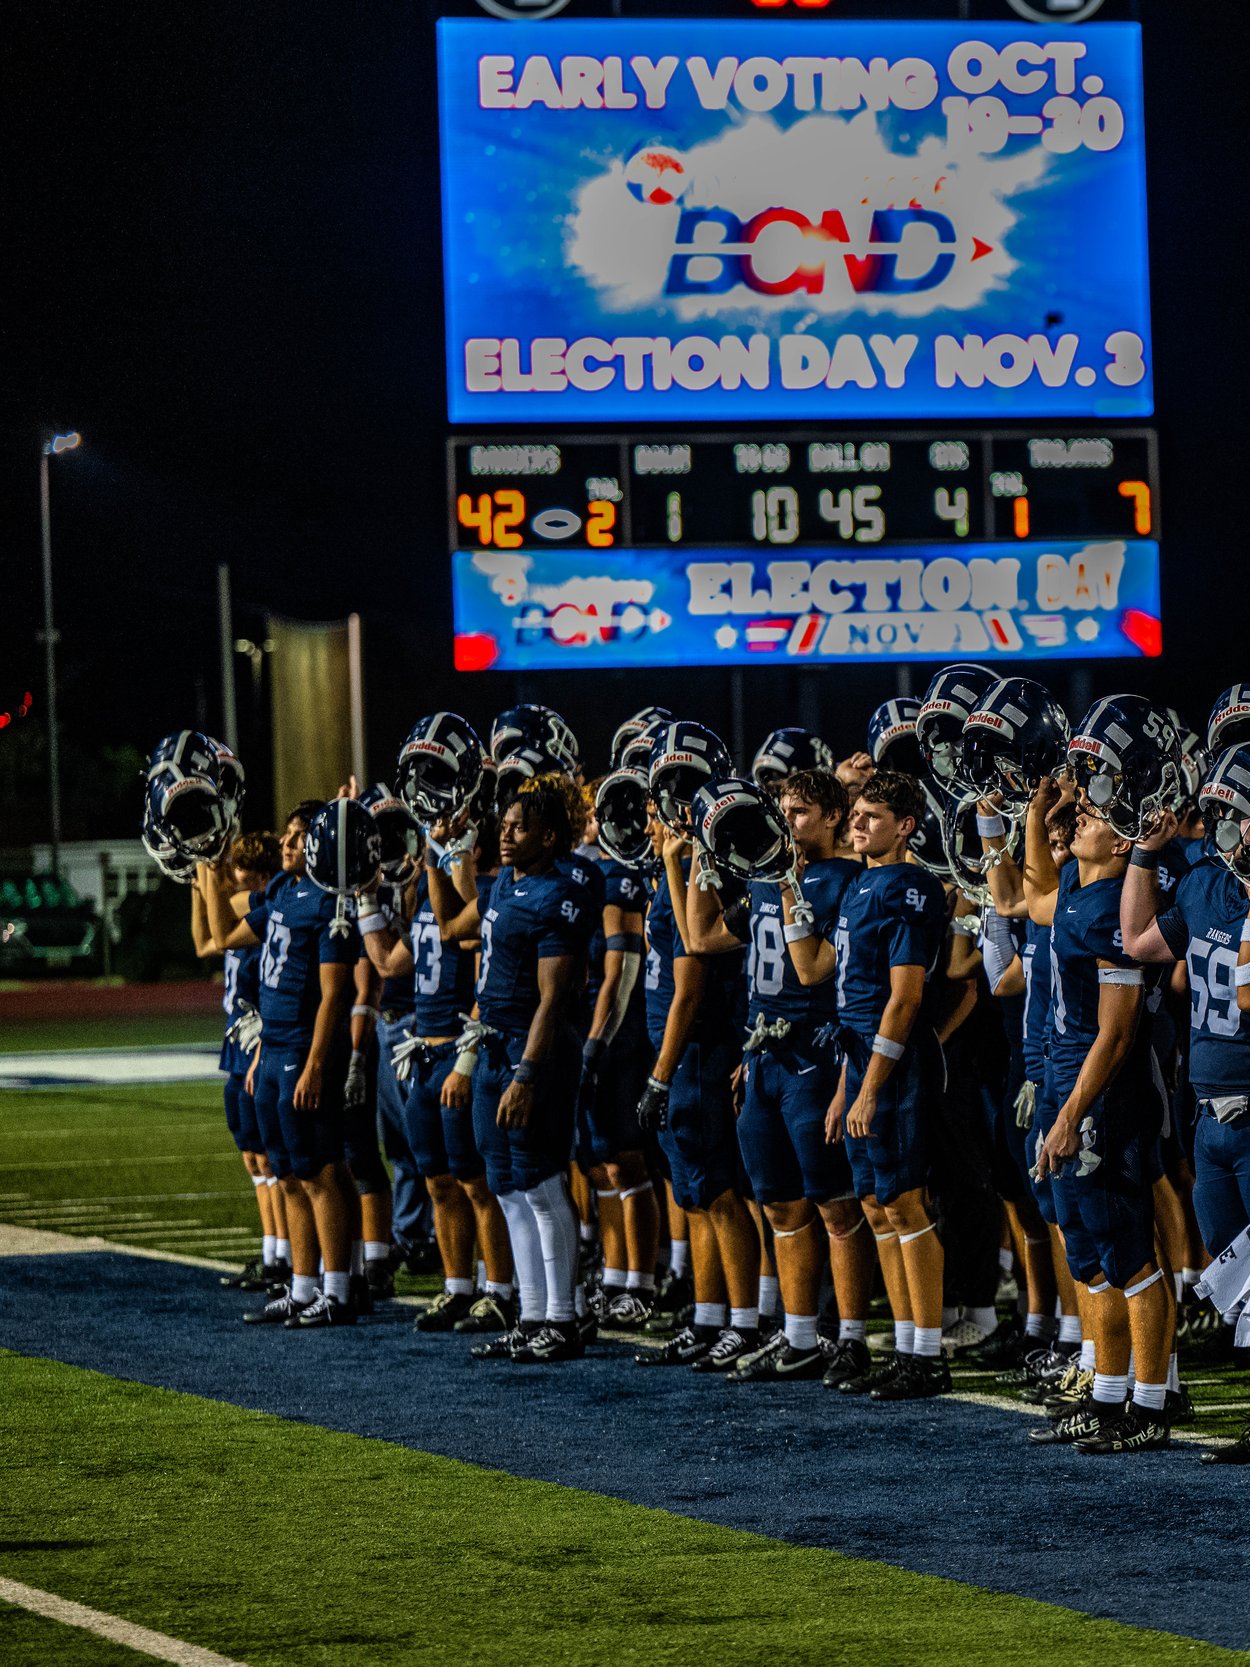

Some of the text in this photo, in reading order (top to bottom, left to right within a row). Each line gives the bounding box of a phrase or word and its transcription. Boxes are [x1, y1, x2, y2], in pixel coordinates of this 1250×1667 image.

[479, 40, 1104, 111] EARLY VOTING OCT.
[466, 331, 1145, 391] ELECTION DAY NOV. 3
[457, 489, 526, 548] 42
[586, 500, 616, 547] 2
[667, 491, 682, 542] 1
[752, 486, 799, 543] 10
[819, 485, 885, 542] 45
[935, 487, 969, 537] 4
[1014, 496, 1030, 538] 1
[1118, 480, 1151, 535] 7
[687, 558, 1021, 614] ELECTION
[1143, 711, 1175, 752] 59
[561, 901, 580, 923] SV
[906, 888, 927, 912] SV
[1206, 927, 1232, 945] RANGERS
[1186, 936, 1241, 1037] 59
